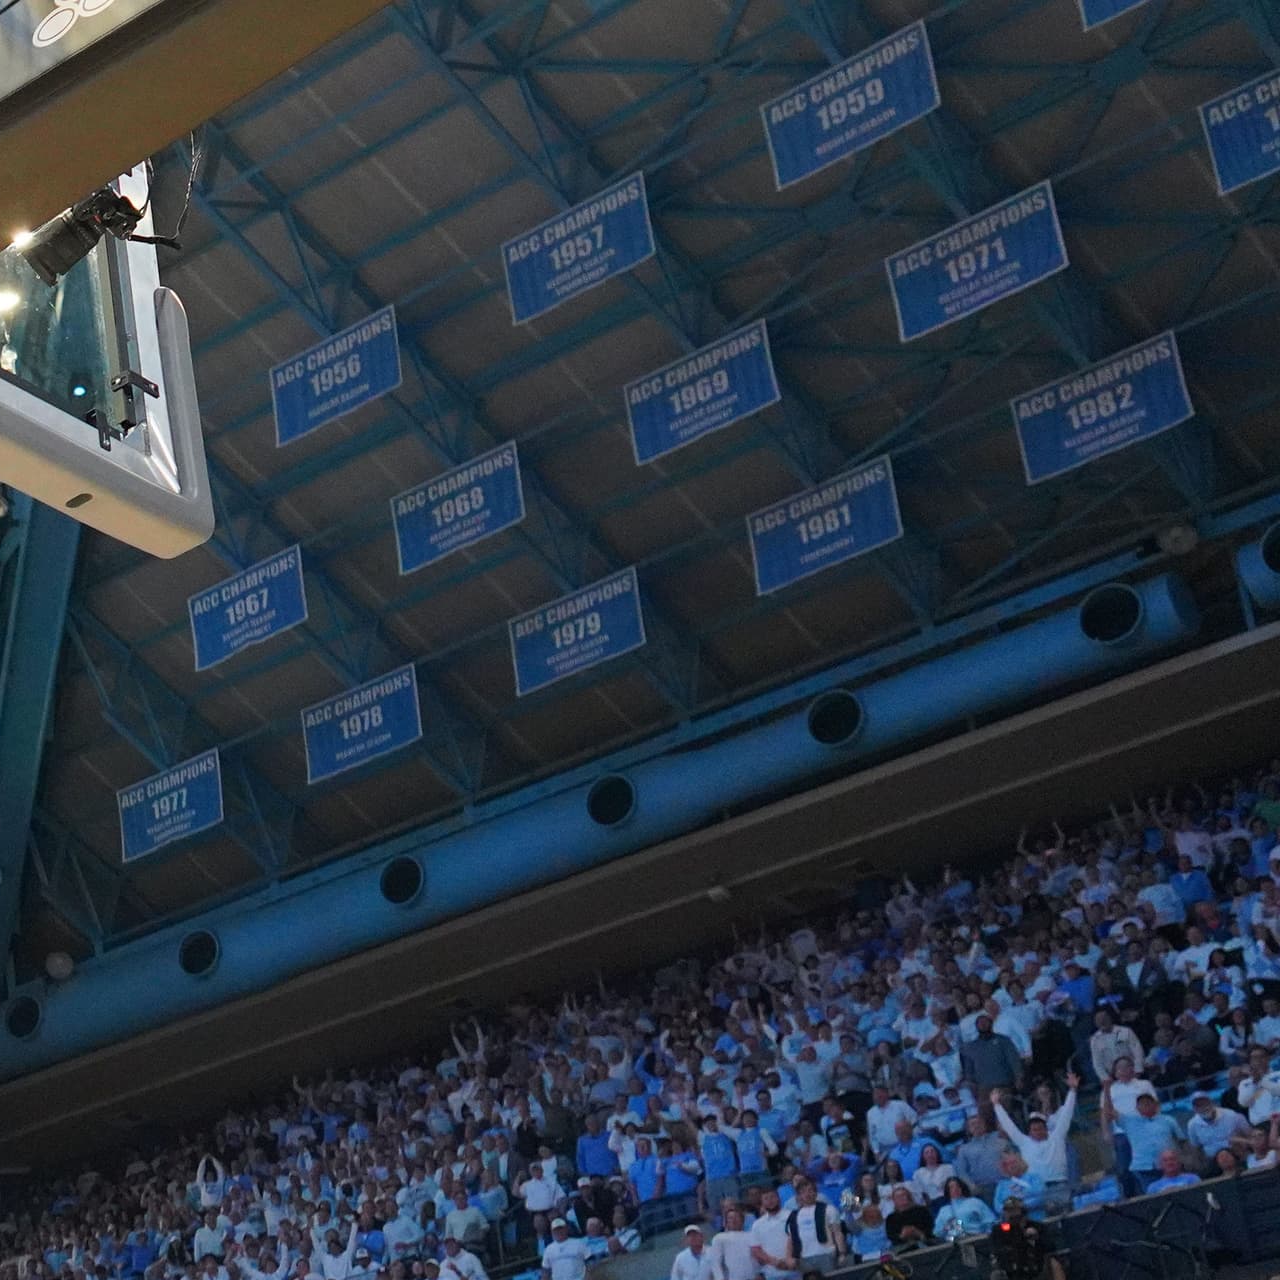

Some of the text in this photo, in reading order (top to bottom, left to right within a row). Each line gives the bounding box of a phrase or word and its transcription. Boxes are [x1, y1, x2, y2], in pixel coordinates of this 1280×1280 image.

[771, 32, 920, 125] ACC CHAMPIONS
[816, 78, 886, 131] 1959
[1209, 92, 1253, 126] ACC
[509, 181, 639, 264] ACC CHAMPIONS
[550, 223, 604, 271] 1957
[896, 190, 1048, 279] ACC CHAMPIONS
[944, 236, 1008, 284] 1971
[275, 313, 390, 388] ACC CHAMPIONS
[310, 353, 361, 397] 1956
[630, 329, 762, 406] ACC CHAMPIONS
[669, 369, 729, 415] 1969
[1019, 341, 1171, 419] ACC CHAMPIONS
[1067, 383, 1135, 430] 1982
[398, 449, 514, 518] ACC CHAMPIONS
[754, 464, 886, 536] ACC CHAMPIONS
[796, 502, 851, 545] 1981
[194, 552, 296, 617] ACC CHAMPIONS
[225, 587, 269, 626] 1967
[515, 574, 633, 639] ACC CHAMPIONS
[553, 611, 601, 649] 1979
[306, 671, 411, 729] ACC CHAMPIONS
[339, 704, 384, 740] 1978
[121, 755, 215, 809] ACC CHAMPIONS
[152, 786, 188, 820] 1977
